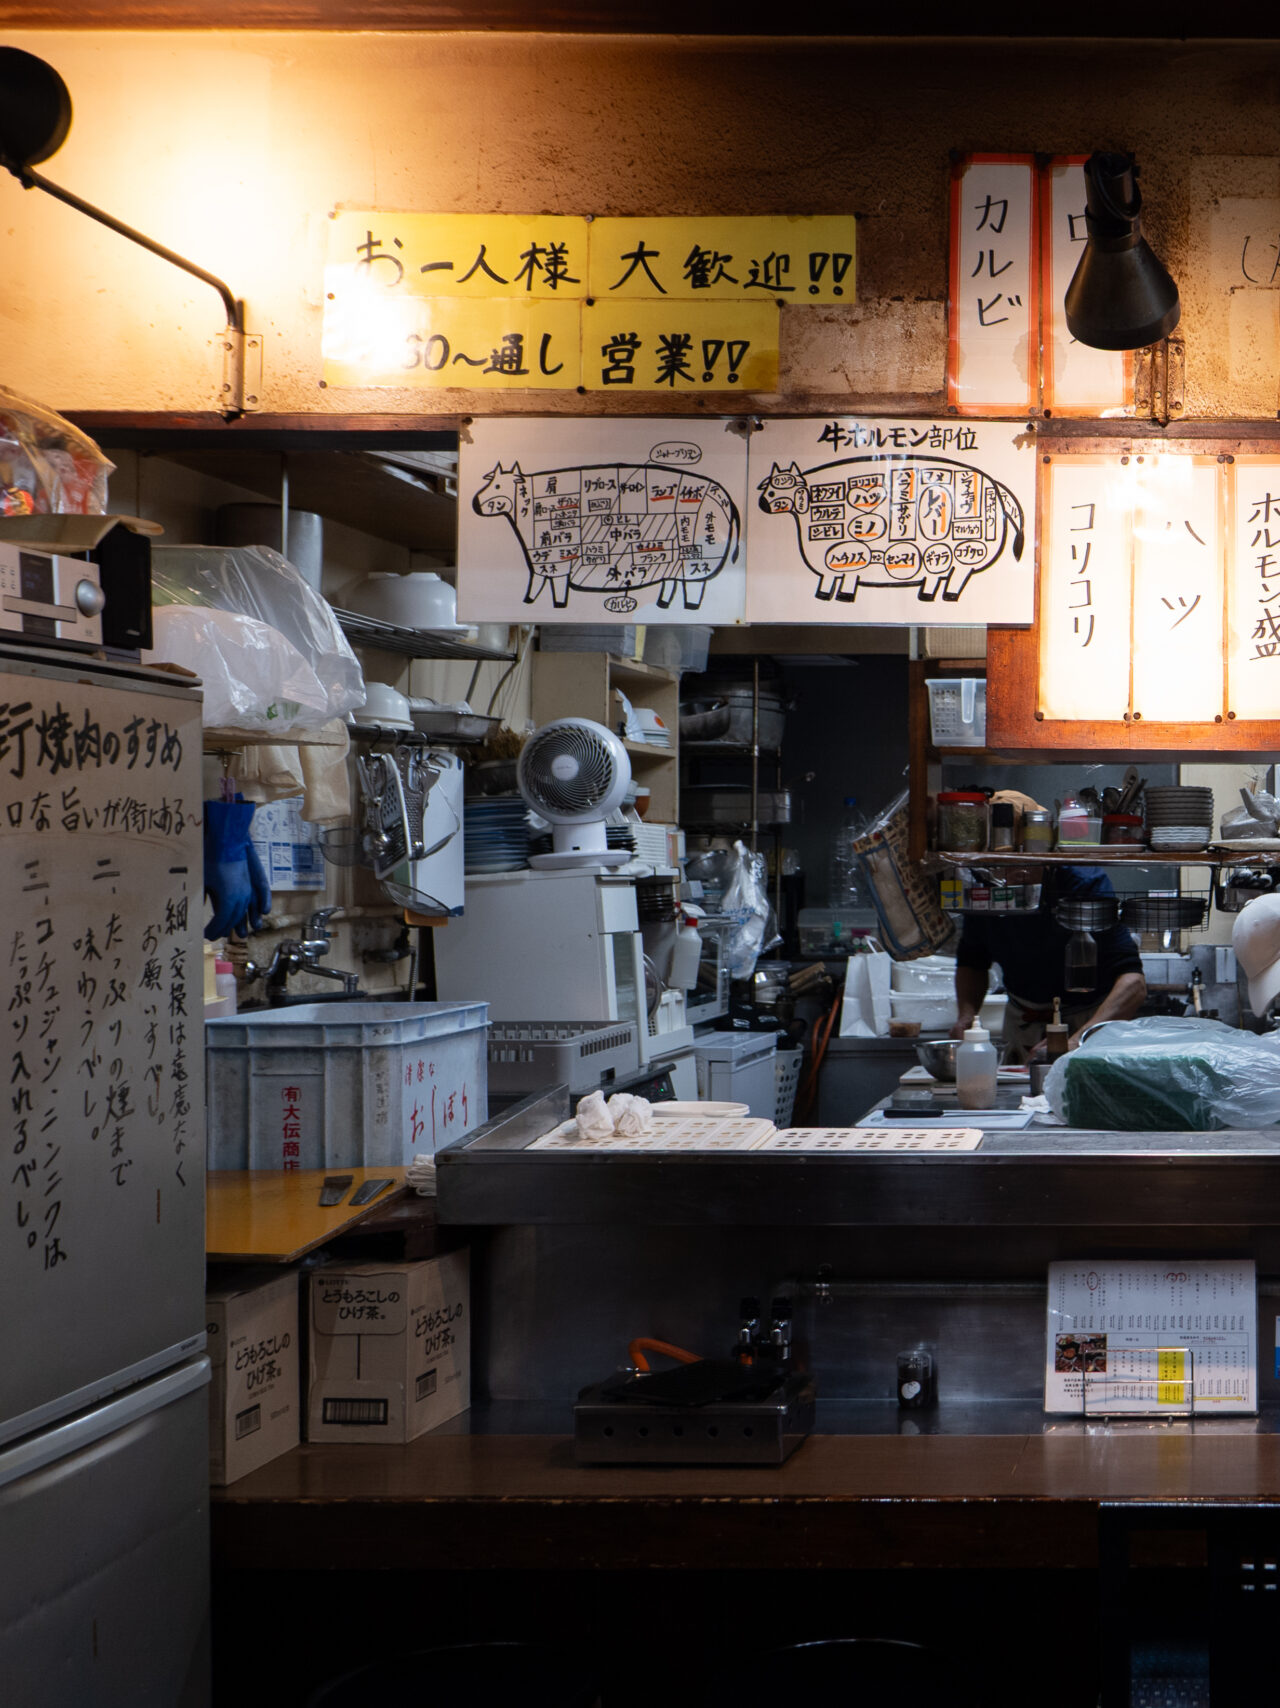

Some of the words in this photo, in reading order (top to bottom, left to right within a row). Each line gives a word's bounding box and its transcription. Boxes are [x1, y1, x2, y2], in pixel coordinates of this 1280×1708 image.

[354, 230, 581, 292] お一人様
[971, 194, 1022, 326] カルビ
[818, 421, 979, 452] 牛ホルモン部位
[851, 477, 880, 487] コリコリ
[926, 471, 945, 481] マメ
[545, 477, 558, 495] 肩
[584, 478, 617, 493] リブロース
[651, 483, 678, 497] ランプ
[680, 483, 704, 498] イチボ
[813, 486, 842, 500] ネクタイ
[897, 472, 911, 501] ハラミ
[960, 472, 974, 514] シマチョウ
[518, 484, 529, 518] ネック
[709, 485, 731, 508] テール
[853, 492, 881, 505] ハツ
[487, 500, 507, 512] タン
[773, 500, 789, 510] タン
[1000, 491, 1019, 518] テール
[813, 508, 842, 520] ウルテ
[897, 504, 911, 537] サガリ
[924, 490, 943, 536] レバー
[609, 524, 642, 541] 中バラ
[680, 515, 690, 543] 内モモ
[704, 512, 716, 546] 外モモ
[812, 525, 841, 537] シビレ
[854, 521, 875, 535] ミノ
[954, 525, 980, 535] マルチョウ
[540, 531, 573, 546] 前バラ
[532, 549, 552, 563] ウデ
[584, 545, 604, 555] ハラミ
[830, 551, 867, 563] ハチノス
[956, 546, 984, 558] コブクロ
[640, 554, 667, 563] フランク
[886, 552, 915, 566] センマイ
[926, 551, 950, 566] ギアラ
[540, 565, 558, 574] スネ
[606, 567, 649, 582] 外バラ
[690, 562, 711, 576] スネ
[1068, 503, 1096, 648] コリコリ
[410, 1081, 468, 1148] おしぼり
[322, 1289, 400, 1304] とうもろこしの
[415, 1303, 463, 1338] とうもろこしの
[234, 1333, 290, 1371] とうもろこしの
